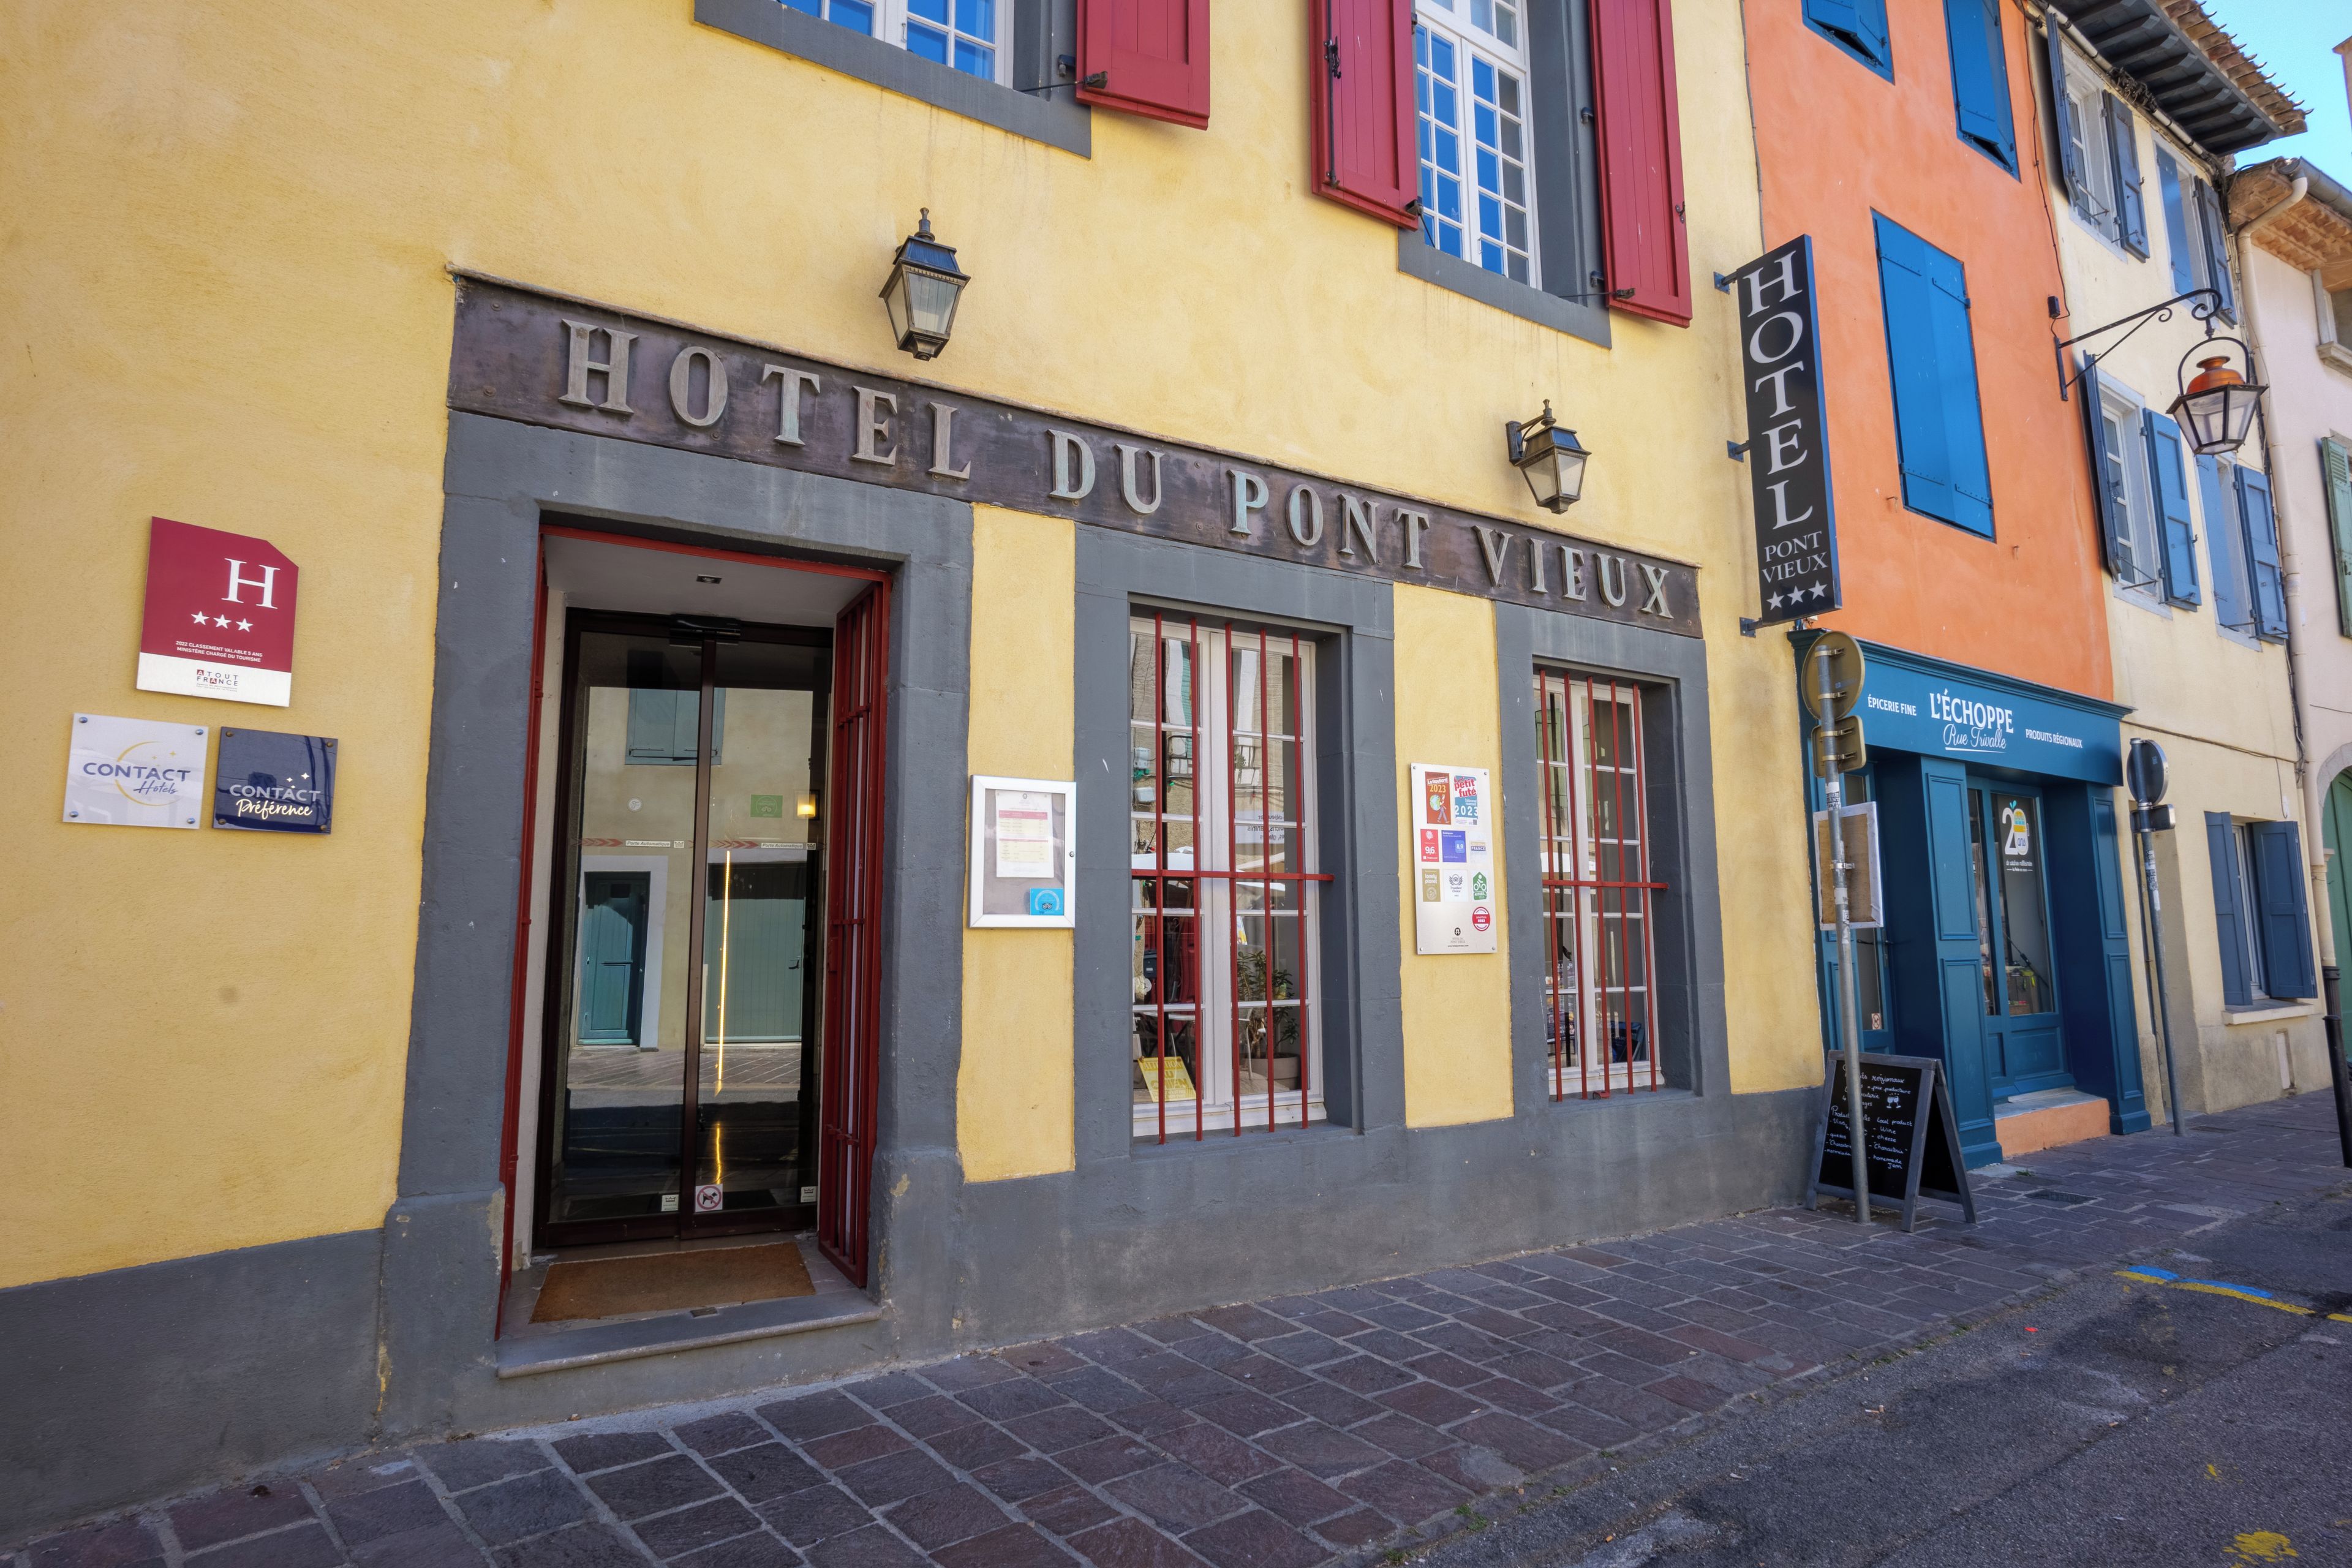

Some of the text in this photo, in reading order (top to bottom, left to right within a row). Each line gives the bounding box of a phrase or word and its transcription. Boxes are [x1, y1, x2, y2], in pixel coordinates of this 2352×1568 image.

[1742, 250, 1814, 529] HOTEL
[559, 318, 1674, 619] HOTEL DU PONT VIEUX
[1764, 530, 1822, 562] PONT
[1762, 551, 1828, 583] VIEUX
[221, 557, 280, 609] H
[176, 646, 205, 655] MINISTÈRE
[189, 643, 224, 651] CLASSEMENT
[197, 669, 238, 680] ATOUT
[197, 676, 238, 686] FRANCE
[1868, 694, 1917, 716] ÉPICERIE FINE
[1929, 688, 2014, 734] L'ÉCHOPPE
[1943, 724, 2007, 749] Rue Trivalle
[2026, 728, 2083, 748] PRODUITS RÉGIONAUX
[83, 762, 190, 782] CONTACT
[230, 784, 321, 802] CONTACT
[1430, 784, 1446, 793] 2023
[1454, 778, 1475, 791] petit
[1459, 787, 1477, 797] futé
[235, 799, 313, 820] Préférence
[1455, 805, 1478, 816] 2023
